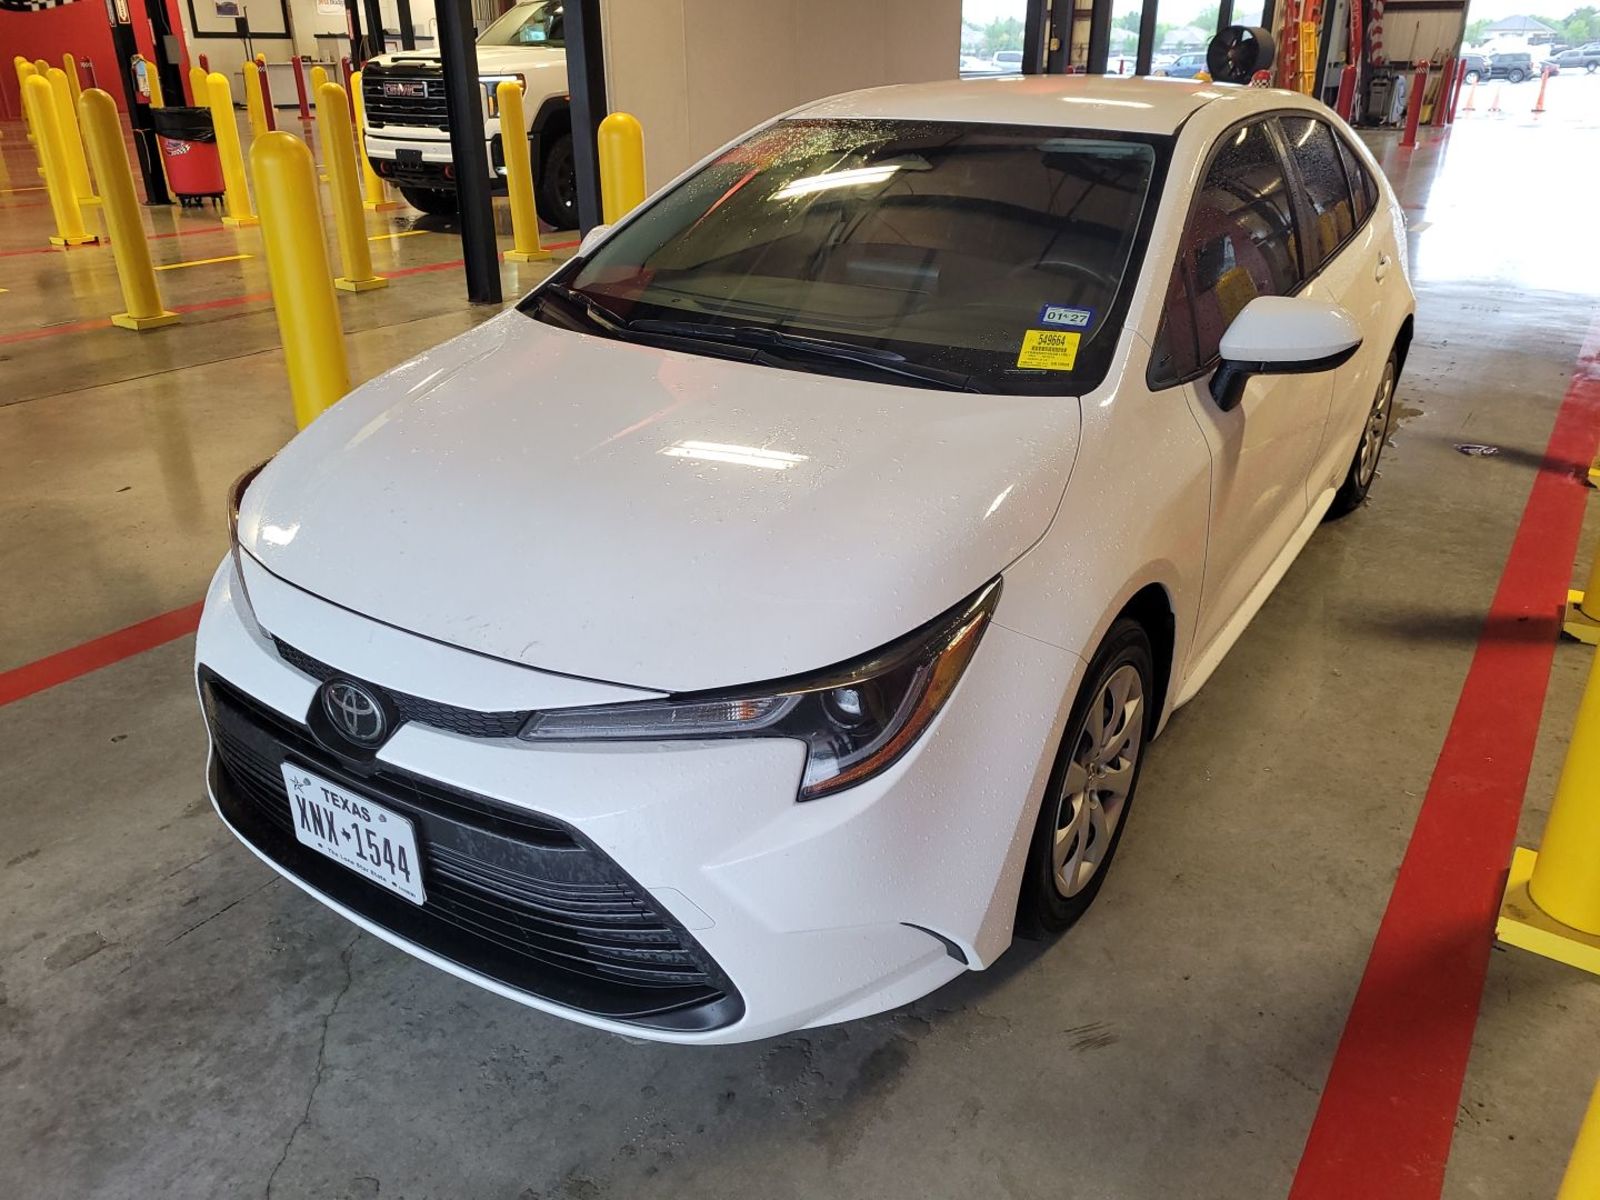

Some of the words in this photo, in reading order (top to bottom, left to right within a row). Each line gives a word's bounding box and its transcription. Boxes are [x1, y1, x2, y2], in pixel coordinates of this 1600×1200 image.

[385, 83, 424, 97] GMC
[1047, 311, 1062, 321] 01
[1070, 313, 1088, 323] 27
[320, 787, 372, 823] TEXAS
